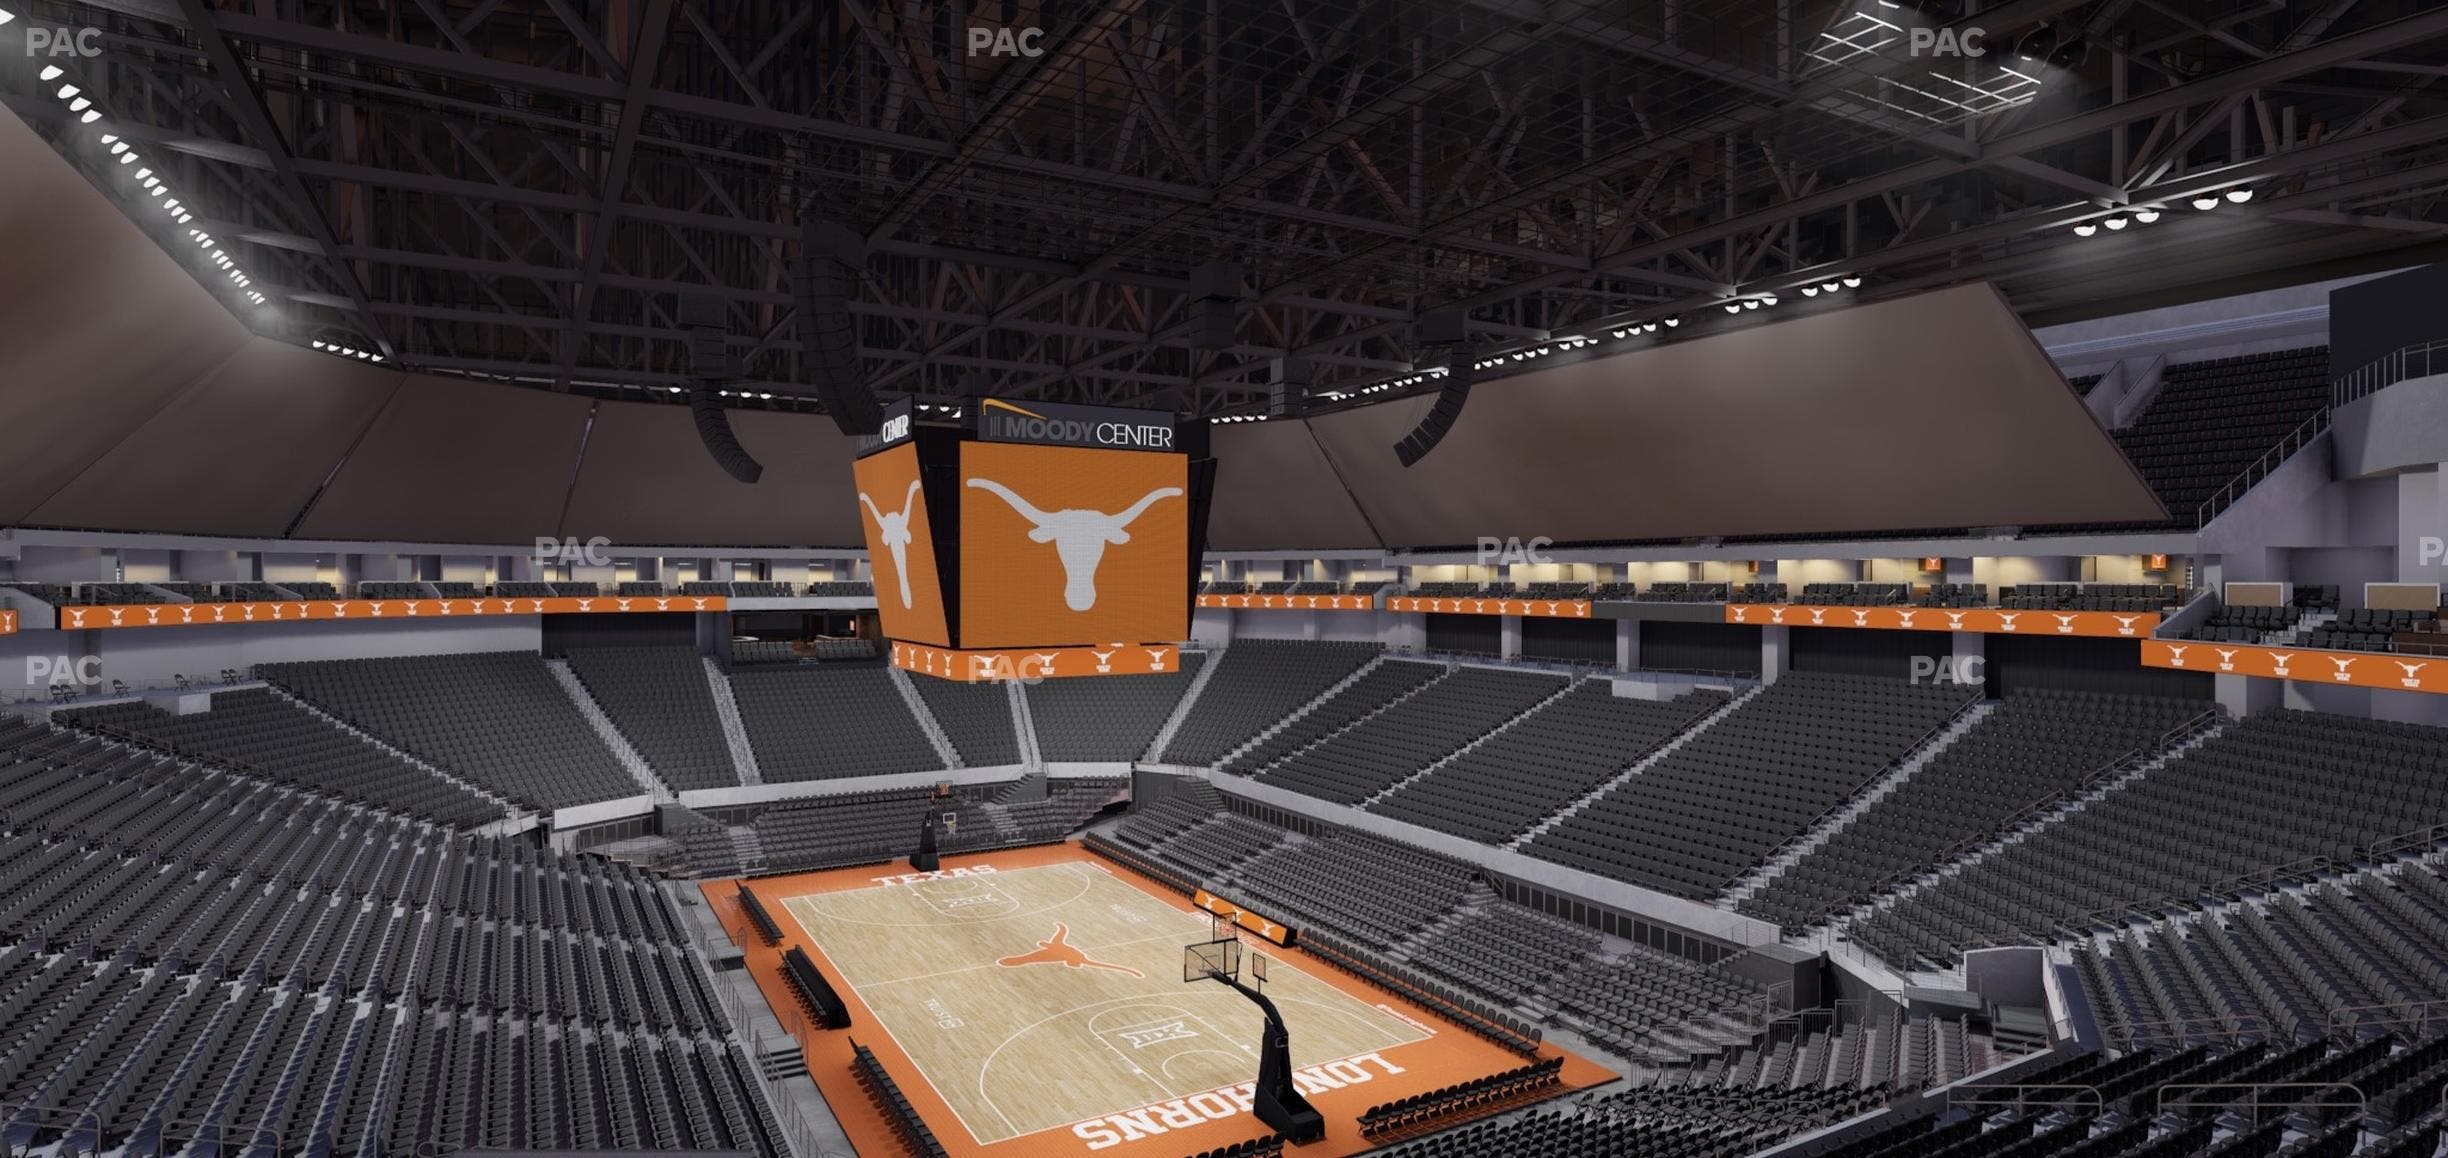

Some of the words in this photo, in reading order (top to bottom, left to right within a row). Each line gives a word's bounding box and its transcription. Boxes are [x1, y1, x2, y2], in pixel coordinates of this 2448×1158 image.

[1005, 415, 1095, 442] MOODY
[1096, 422, 1173, 448] CENTER
[870, 864, 998, 888] TEXAS
